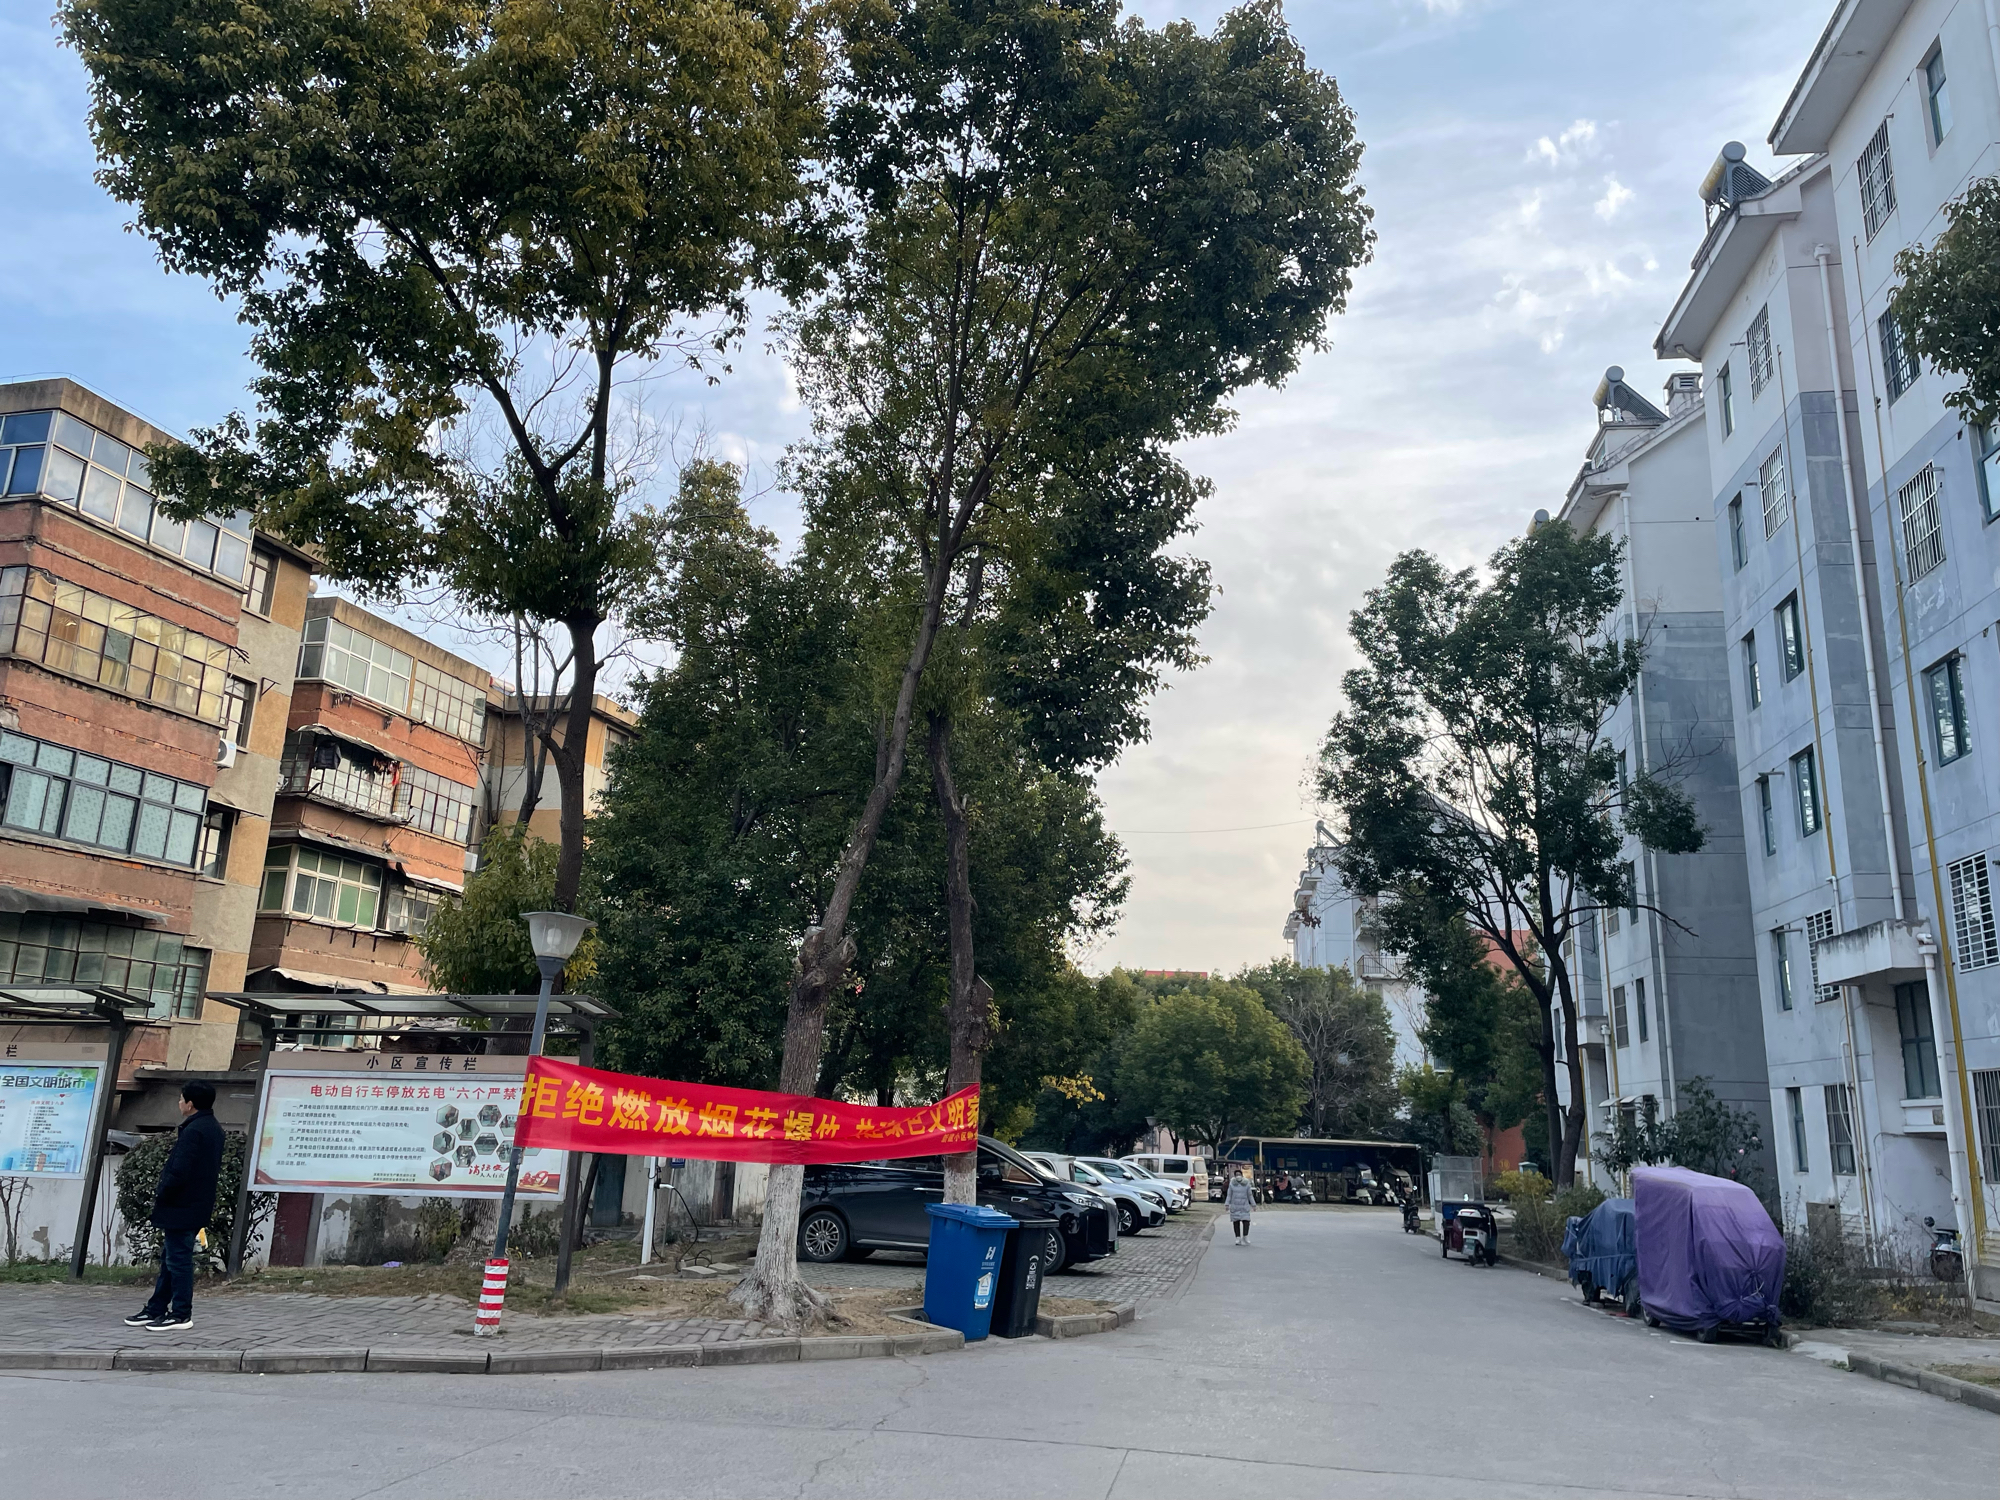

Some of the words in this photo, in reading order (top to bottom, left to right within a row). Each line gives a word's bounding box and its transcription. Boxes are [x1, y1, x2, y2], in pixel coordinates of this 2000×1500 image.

[6, 1044, 17, 1058] 栏
[366, 1055, 477, 1071] 小区宣传栏
[0, 1075, 87, 1089] 全国文明城市
[519, 1073, 841, 1141] 拒绝燃放烟花爆竹
[468, 1163, 509, 1175] 消防安
